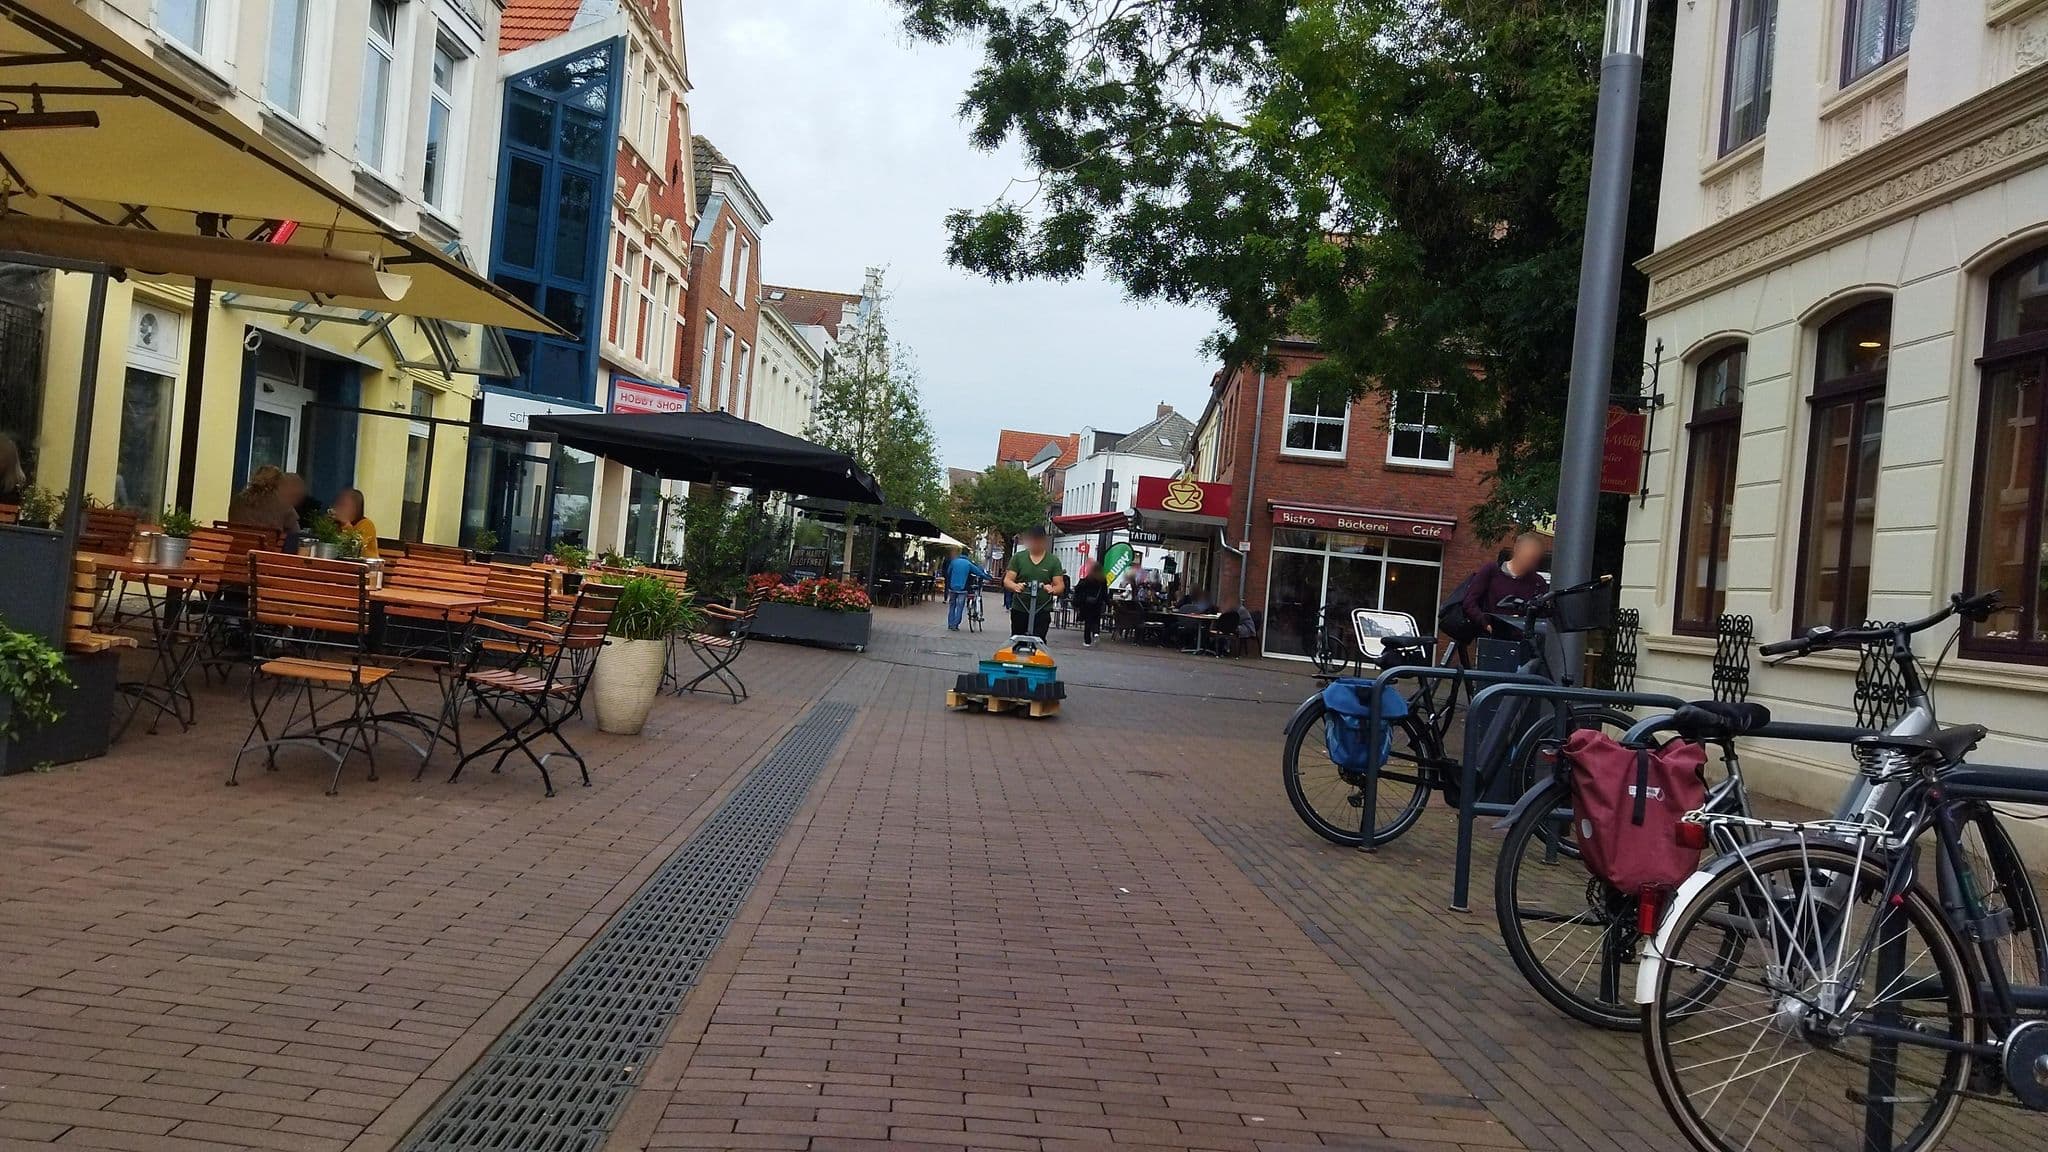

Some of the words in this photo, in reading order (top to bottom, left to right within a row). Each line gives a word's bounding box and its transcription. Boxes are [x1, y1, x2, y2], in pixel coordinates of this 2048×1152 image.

[620, 392, 654, 406] HOBBY
[656, 400, 683, 412] SHOP
[1283, 512, 1316, 525] Bistro
[1338, 518, 1389, 532] Bäckerei
[1412, 525, 1442, 537] Café
[1130, 531, 1157, 541] TATTOO
